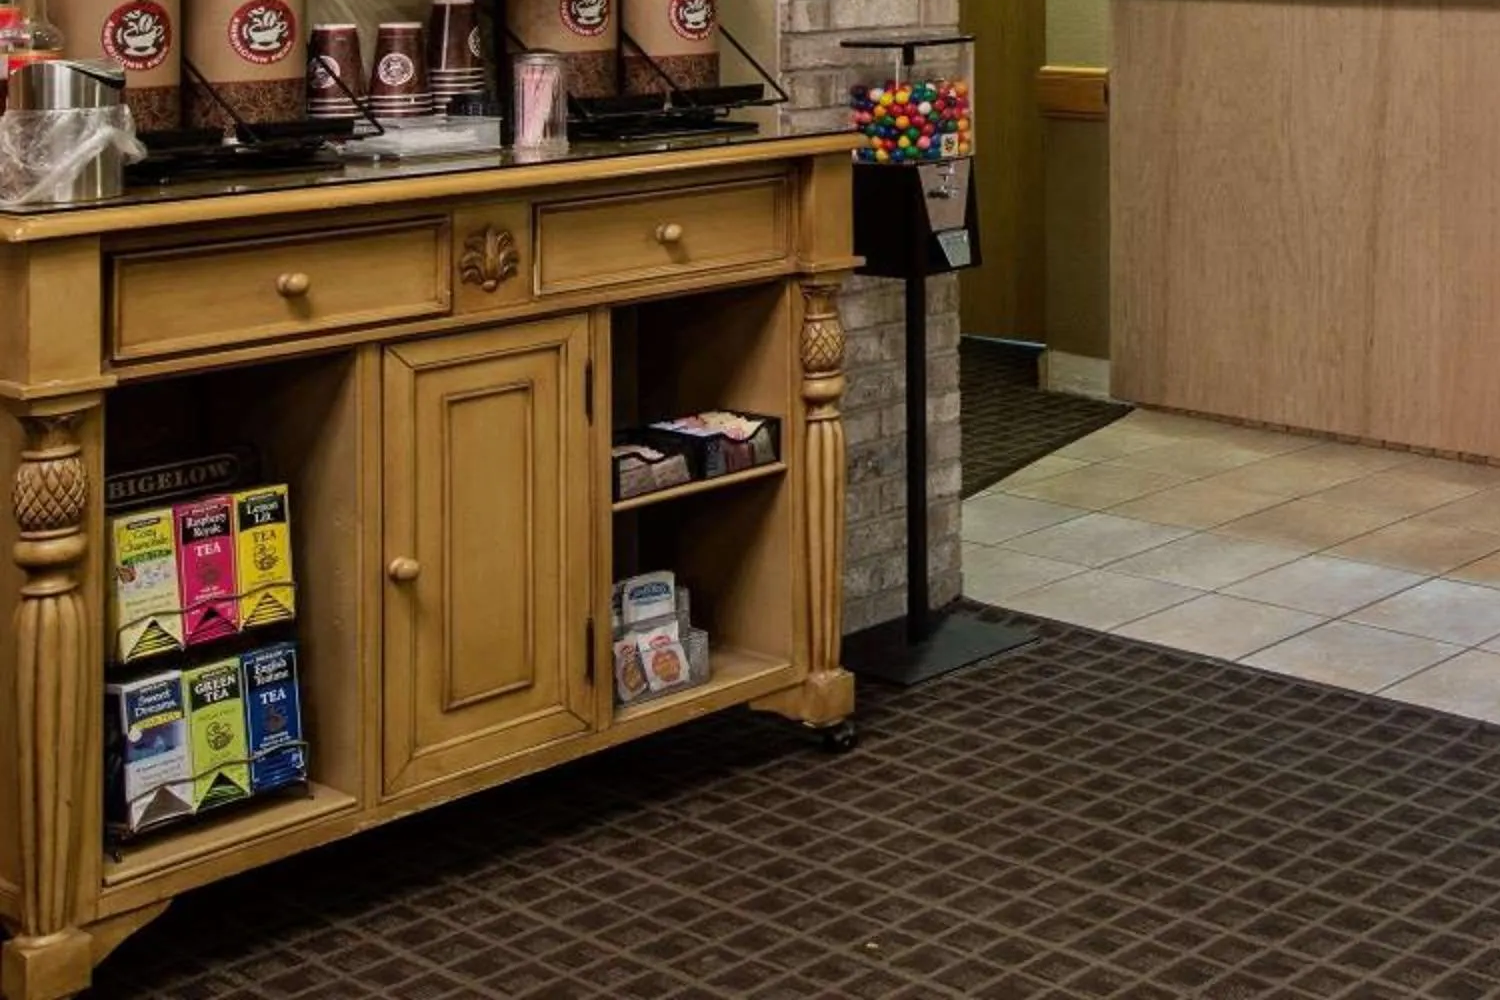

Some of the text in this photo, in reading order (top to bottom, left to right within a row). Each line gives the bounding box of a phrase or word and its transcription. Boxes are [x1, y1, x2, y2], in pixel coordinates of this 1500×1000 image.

[109, 461, 230, 499] BIGELOW
[252, 530, 276, 542] TEA
[194, 542, 221, 557] TEA
[194, 675, 235, 695] GREEN
[204, 689, 229, 703] TEA
[260, 688, 287, 704] TEA
